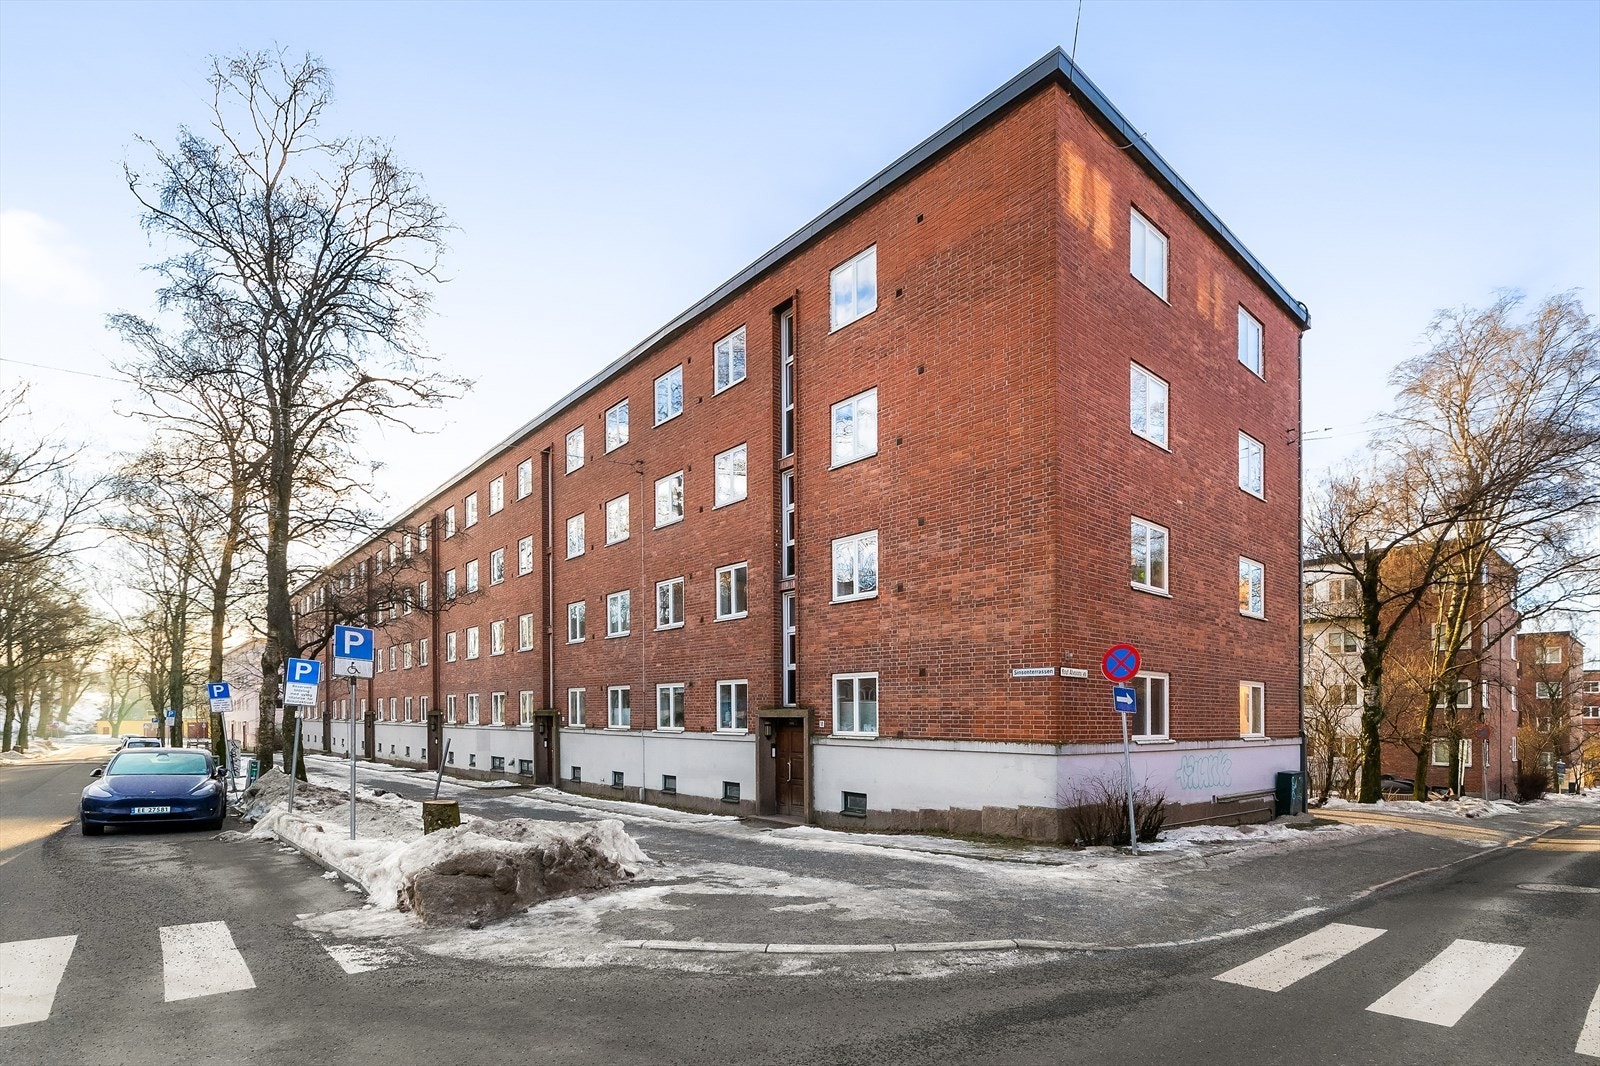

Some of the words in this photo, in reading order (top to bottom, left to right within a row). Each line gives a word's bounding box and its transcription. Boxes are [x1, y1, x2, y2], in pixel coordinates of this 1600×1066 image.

[344, 630, 364, 654] P
[295, 662, 312, 680] P
[213, 685, 225, 697] P
